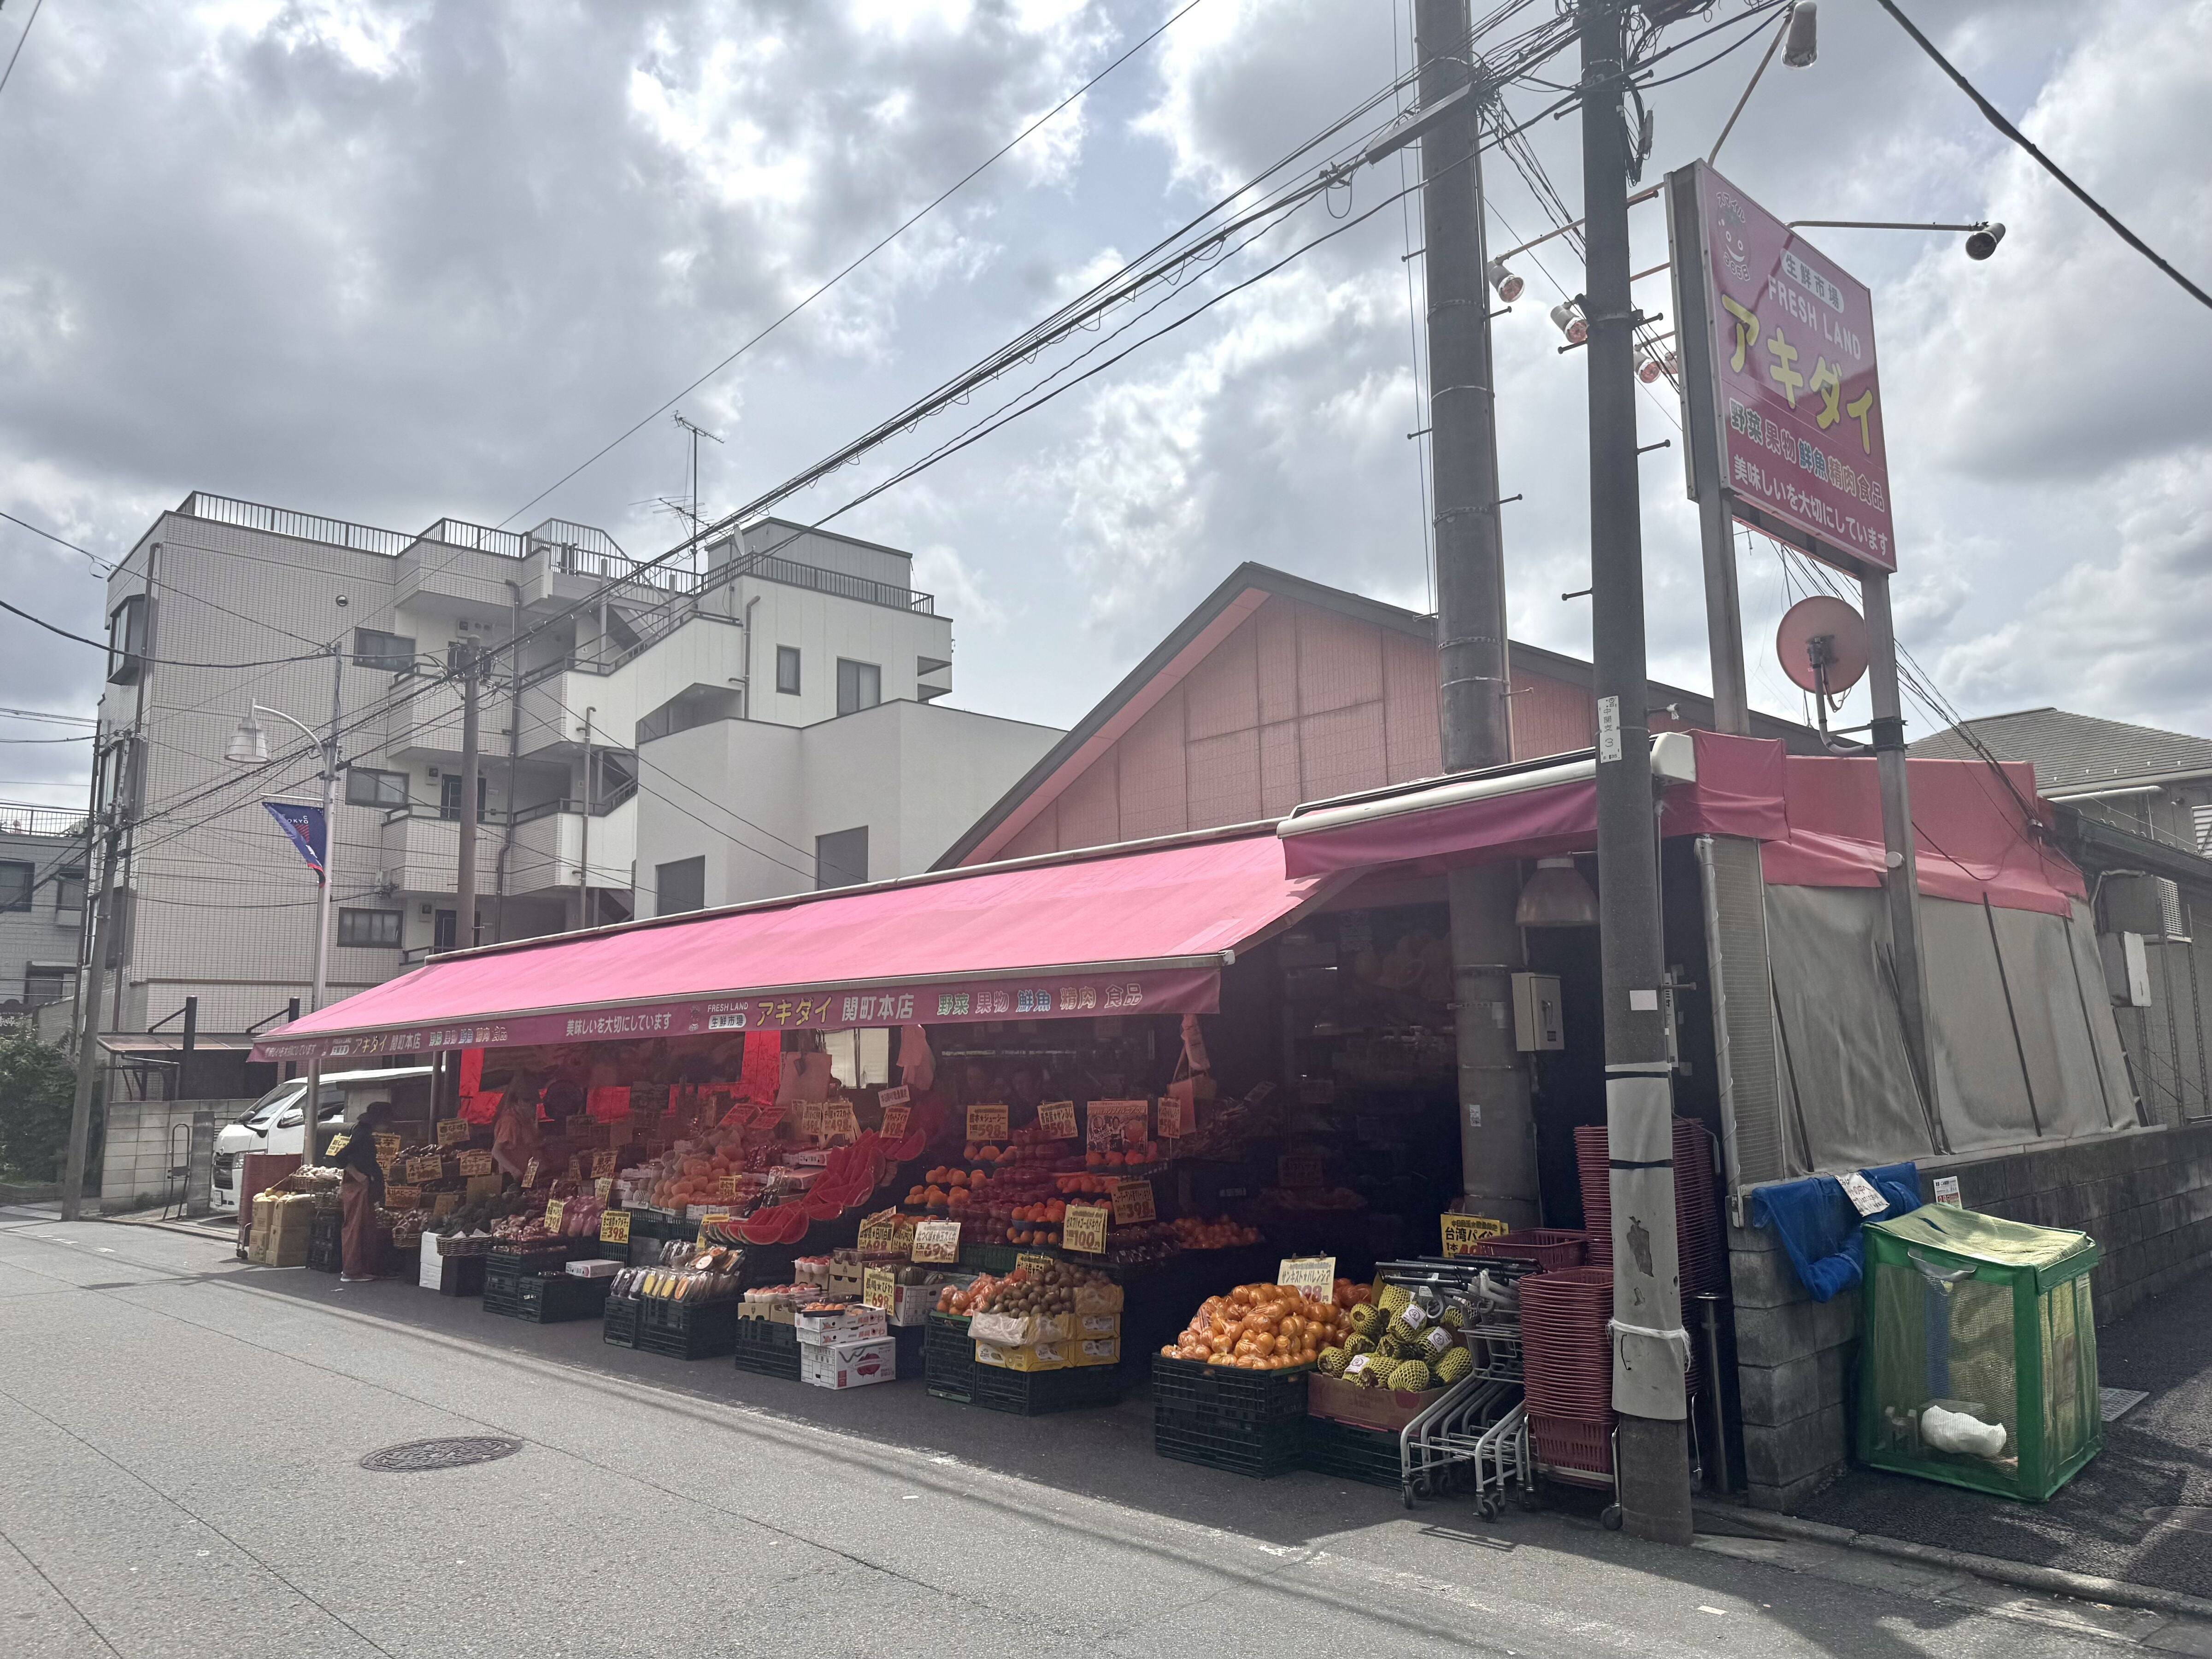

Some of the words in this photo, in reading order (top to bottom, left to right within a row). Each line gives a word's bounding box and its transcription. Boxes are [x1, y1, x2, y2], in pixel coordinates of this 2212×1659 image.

[1716, 192, 1746, 223] スマイル
[1786, 254, 1839, 309] 生鮮市場
[1768, 274, 1818, 331] FRESH
[1823, 312, 1861, 360] LAND
[1721, 293, 1873, 455] アキダイ
[1729, 397, 1763, 446] 野菜
[1765, 419, 1797, 464] 果物
[1798, 437, 1829, 482] 鮮魚
[1828, 455, 1856, 497] 精肉
[1857, 473, 1885, 512] 食品
[1734, 453, 1888, 556] 美味しいを大切にしています
[565, 1012, 672, 1037] 美味しいを大切にしています
[707, 1003, 729, 1013] FRESH
[730, 1001, 749, 1011] LAND
[711, 1015, 744, 1028] 生鮮市場
[756, 996, 832, 1027] アキダイ
[841, 993, 915, 1022] 関町本店
[937, 992, 969, 1015] 野菜
[975, 990, 1010, 1014] 果物
[1015, 988, 1051, 1012] 鮮魚
[1059, 986, 1097, 1010] 精肉
[1104, 983, 1143, 1008] 食品
[353, 1035, 387, 1054] アキダイ
